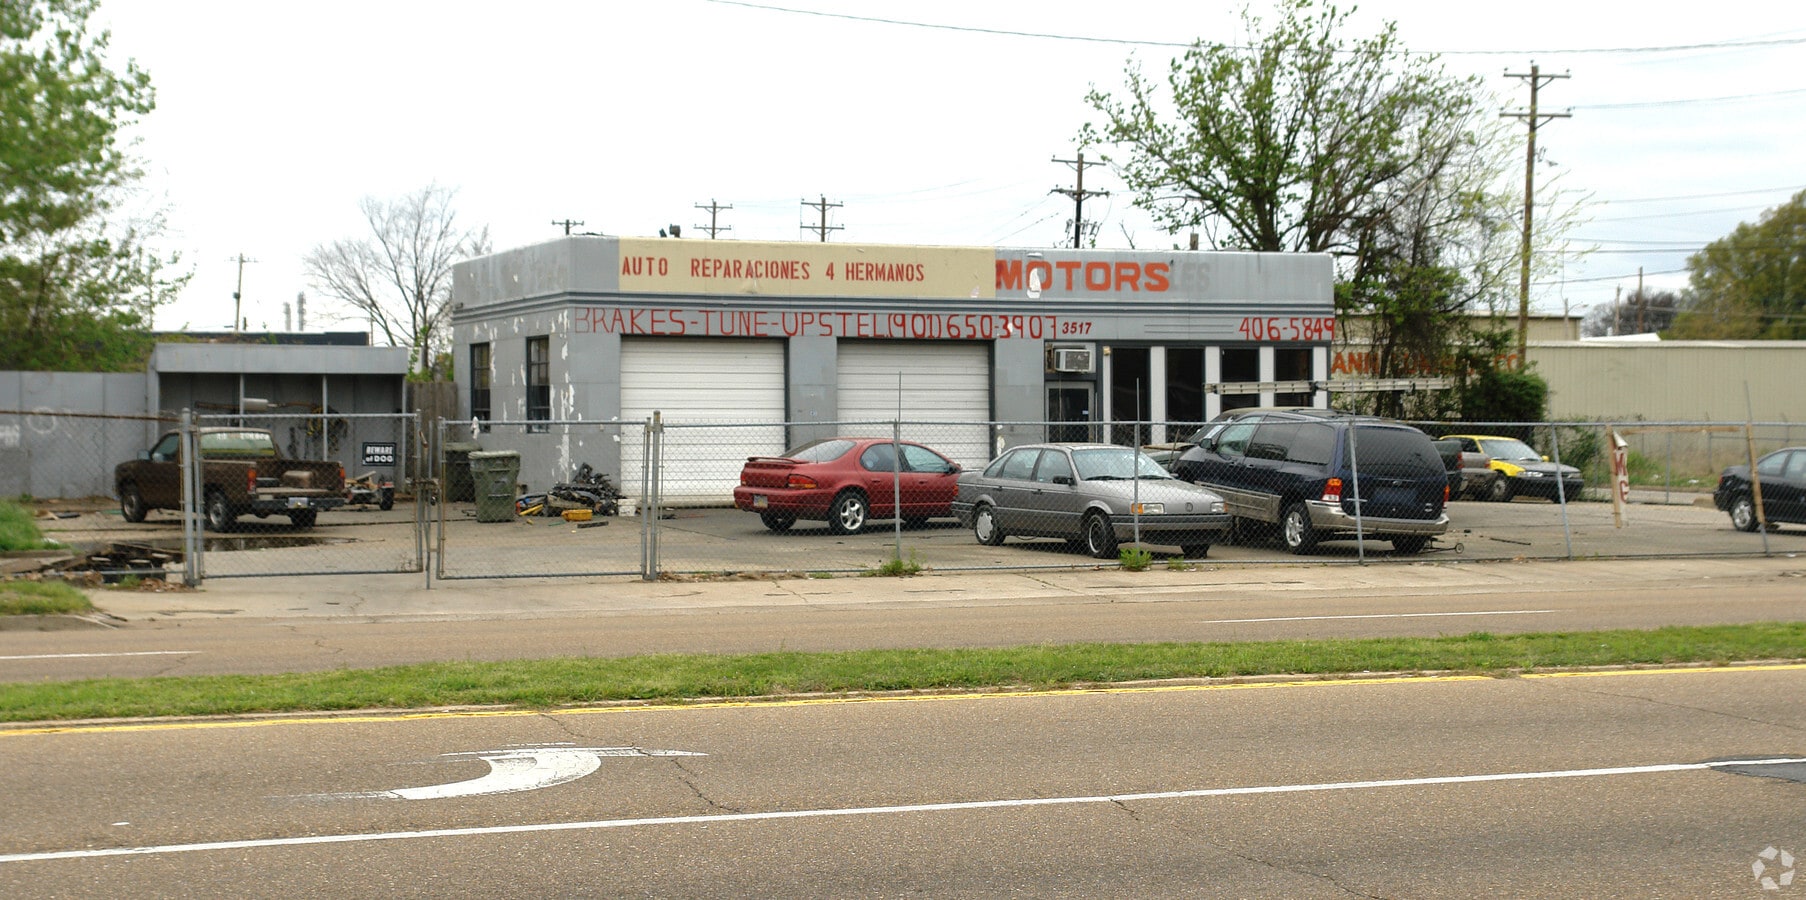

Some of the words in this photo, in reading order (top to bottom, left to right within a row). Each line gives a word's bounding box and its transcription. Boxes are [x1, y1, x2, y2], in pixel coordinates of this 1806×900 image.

[622, 256, 668, 276] AUTO
[691, 258, 810, 280] REPARACIONES
[825, 262, 835, 281] 4
[845, 262, 924, 282] HERMANOS
[995, 260, 1170, 292] MOTORS
[1062, 322, 1092, 335] 3517
[1239, 317, 1335, 341] 406-5849
